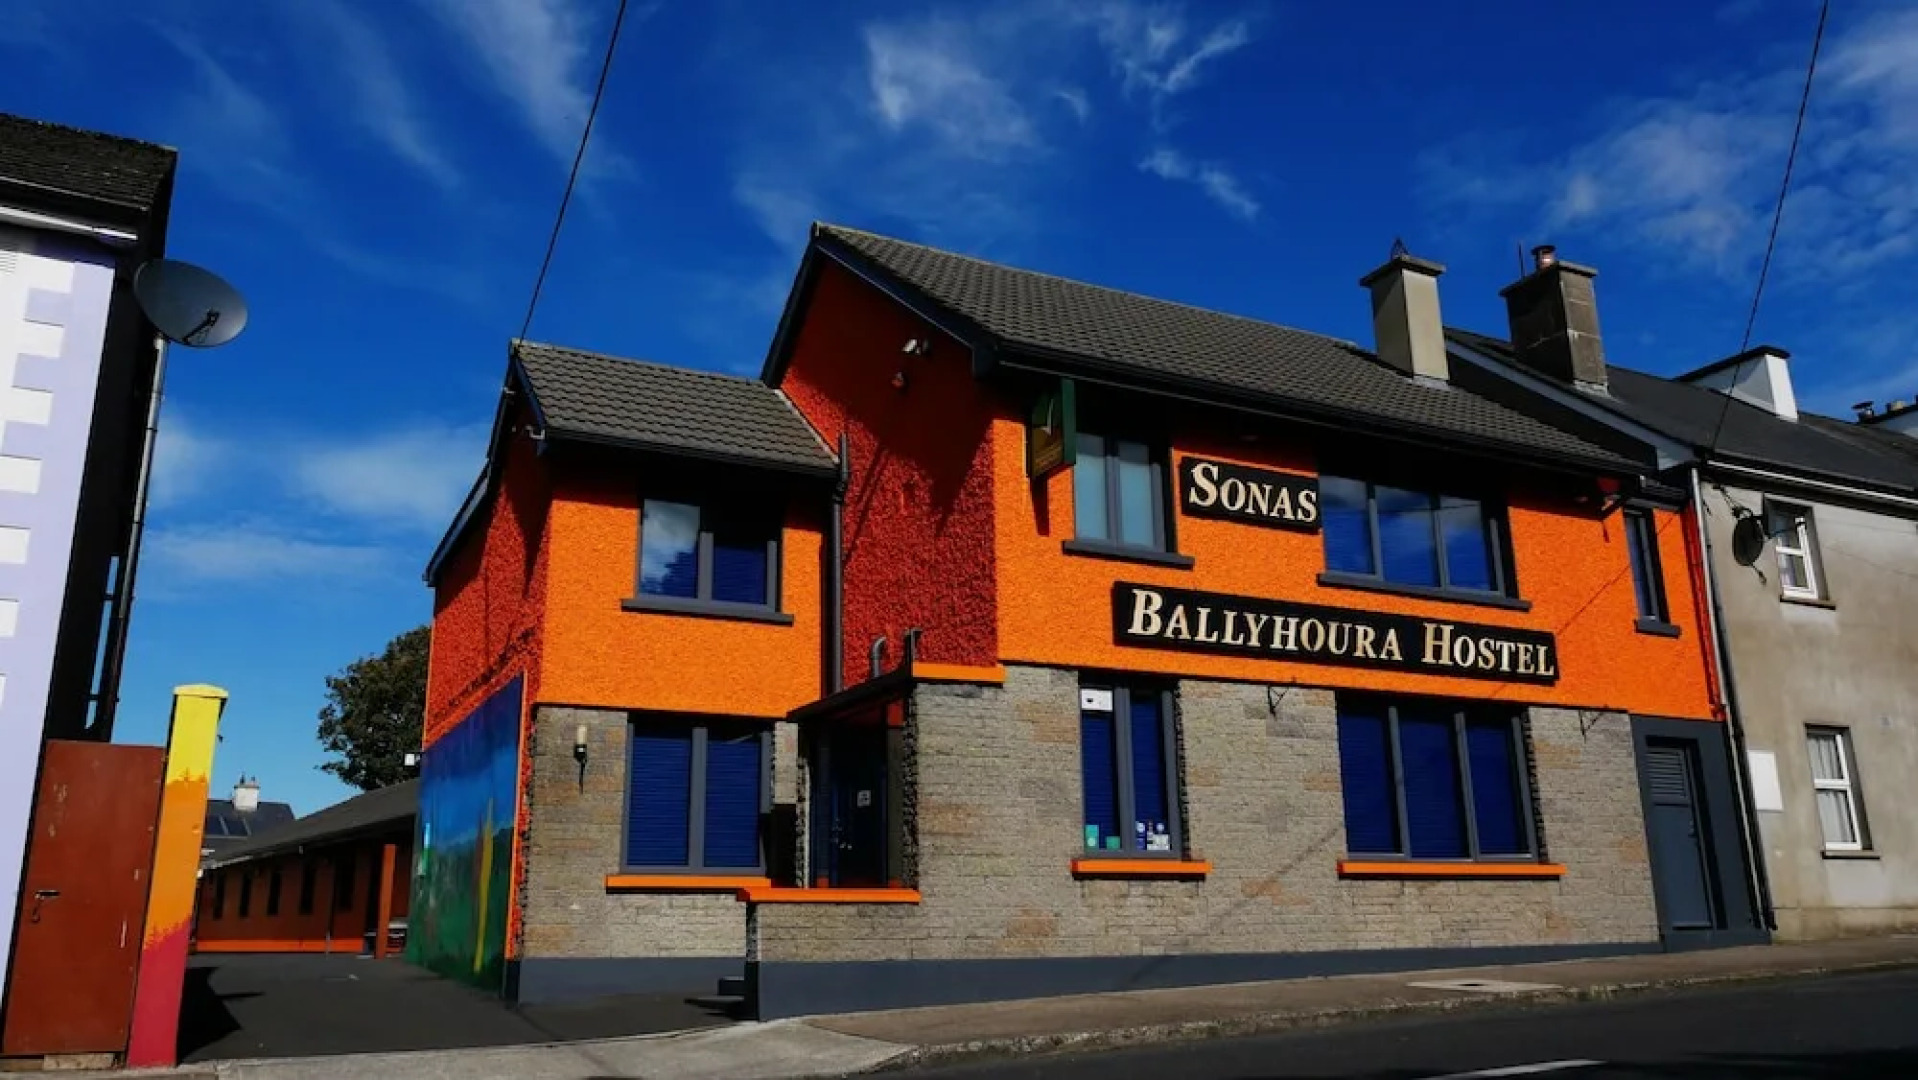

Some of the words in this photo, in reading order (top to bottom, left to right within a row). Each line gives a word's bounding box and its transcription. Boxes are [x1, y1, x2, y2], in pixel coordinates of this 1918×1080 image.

[1188, 461, 1318, 523] SONAS
[1127, 588, 1403, 662] BALLYHOURA
[1421, 622, 1555, 676] HOSTEL
